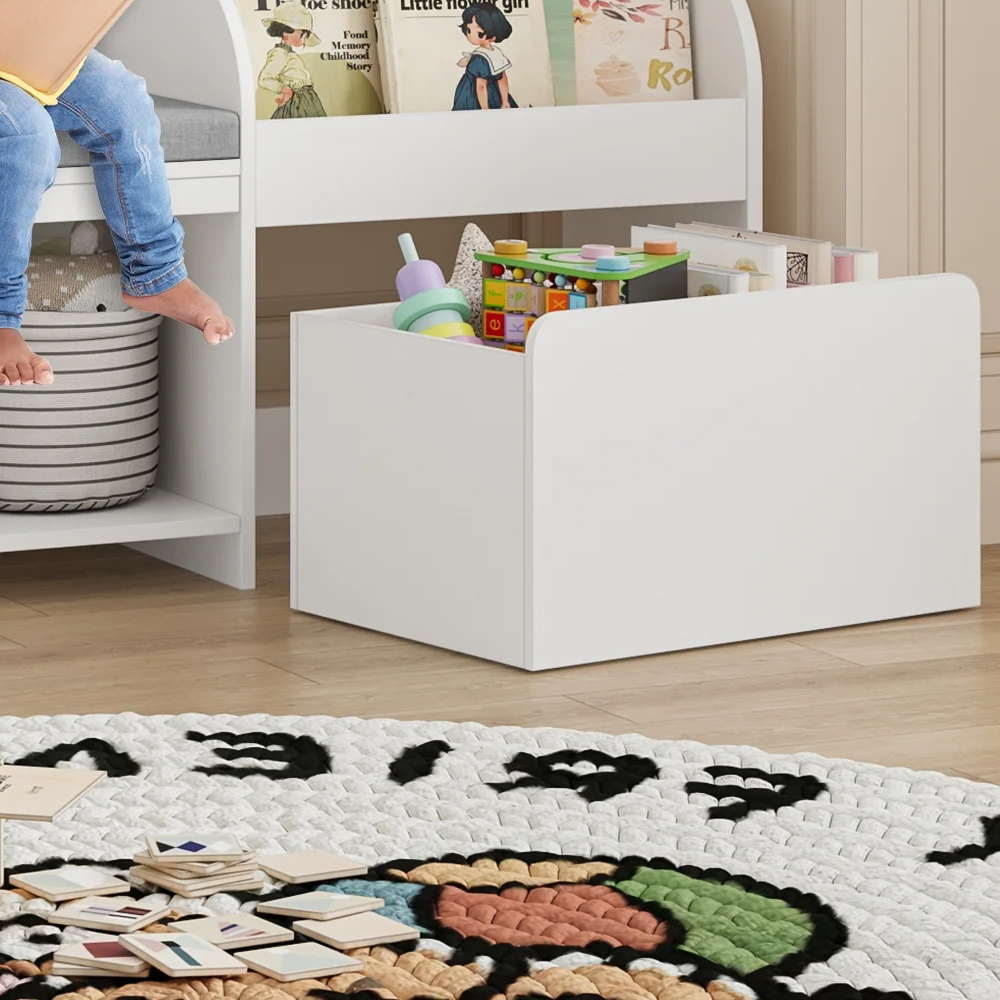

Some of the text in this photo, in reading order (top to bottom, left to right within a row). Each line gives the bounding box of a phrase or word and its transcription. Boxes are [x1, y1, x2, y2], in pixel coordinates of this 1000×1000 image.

[343, 30, 369, 40] Fond
[660, 16, 692, 51] R
[331, 41, 372, 52] Memory
[320, 50, 370, 61] Childhood
[346, 61, 373, 72] Story
[648, 58, 693, 92] Ro
[553, 299, 566, 309] x
[489, 318, 502, 331] e
